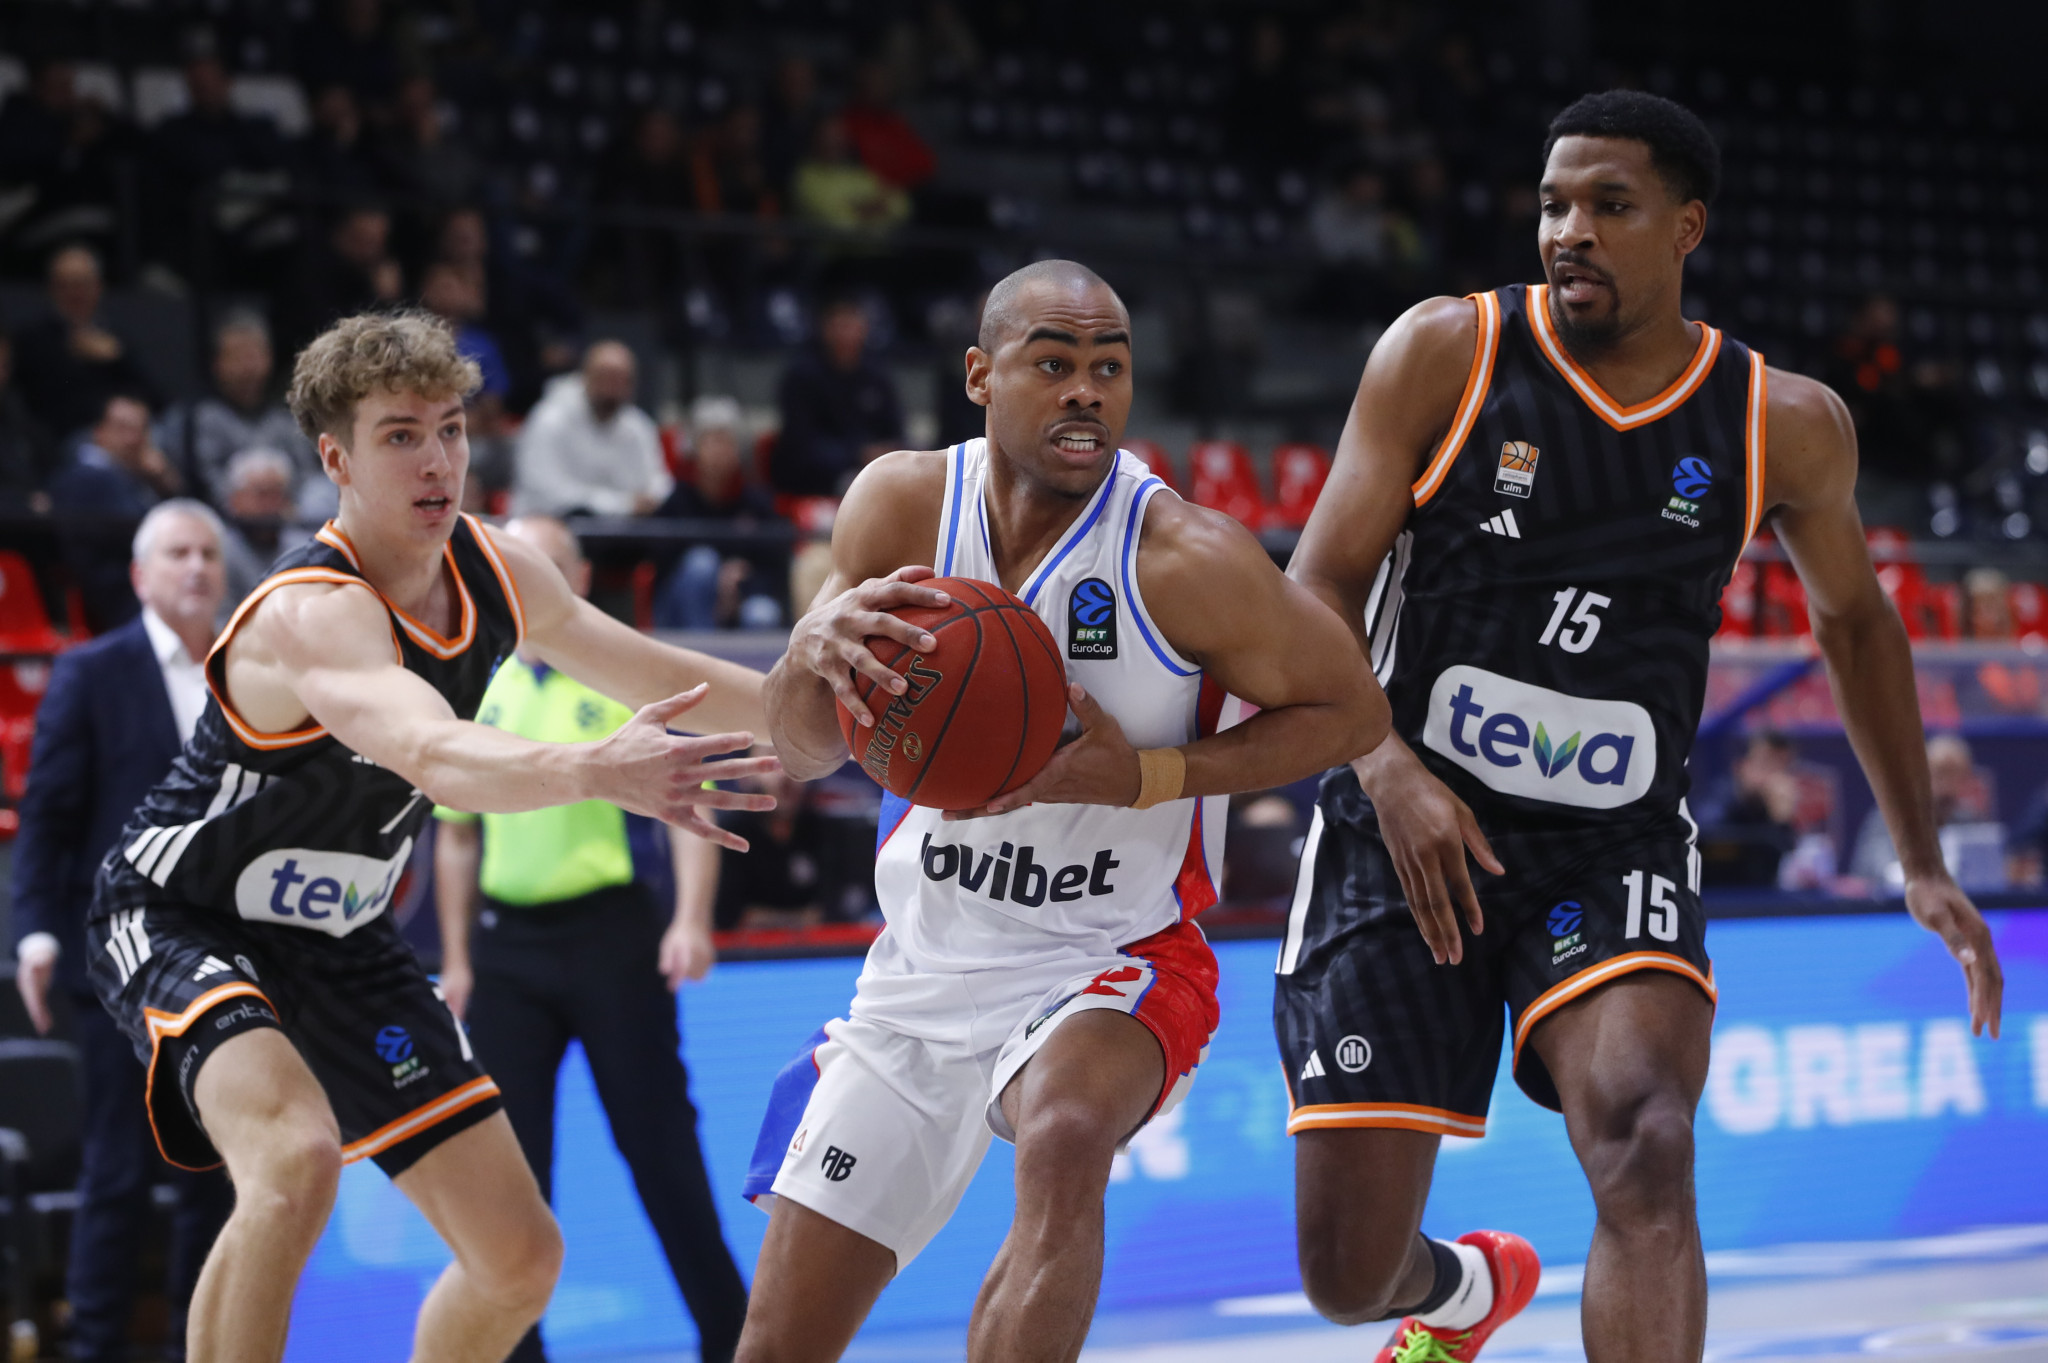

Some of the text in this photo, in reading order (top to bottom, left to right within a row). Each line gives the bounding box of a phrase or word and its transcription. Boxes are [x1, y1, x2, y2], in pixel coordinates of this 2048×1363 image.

[1503, 483, 1522, 494] ulm
[1669, 497, 1699, 513] BKT
[1661, 508, 1700, 528] EuroCup
[1538, 586, 1612, 654] 15
[1076, 629, 1107, 640] BKT
[1071, 643, 1113, 655] EuroCup
[1449, 683, 1635, 786] teva
[1622, 869, 1679, 942] 15
[1554, 932, 1581, 953] BKT
[1551, 943, 1588, 966] EuroCup
